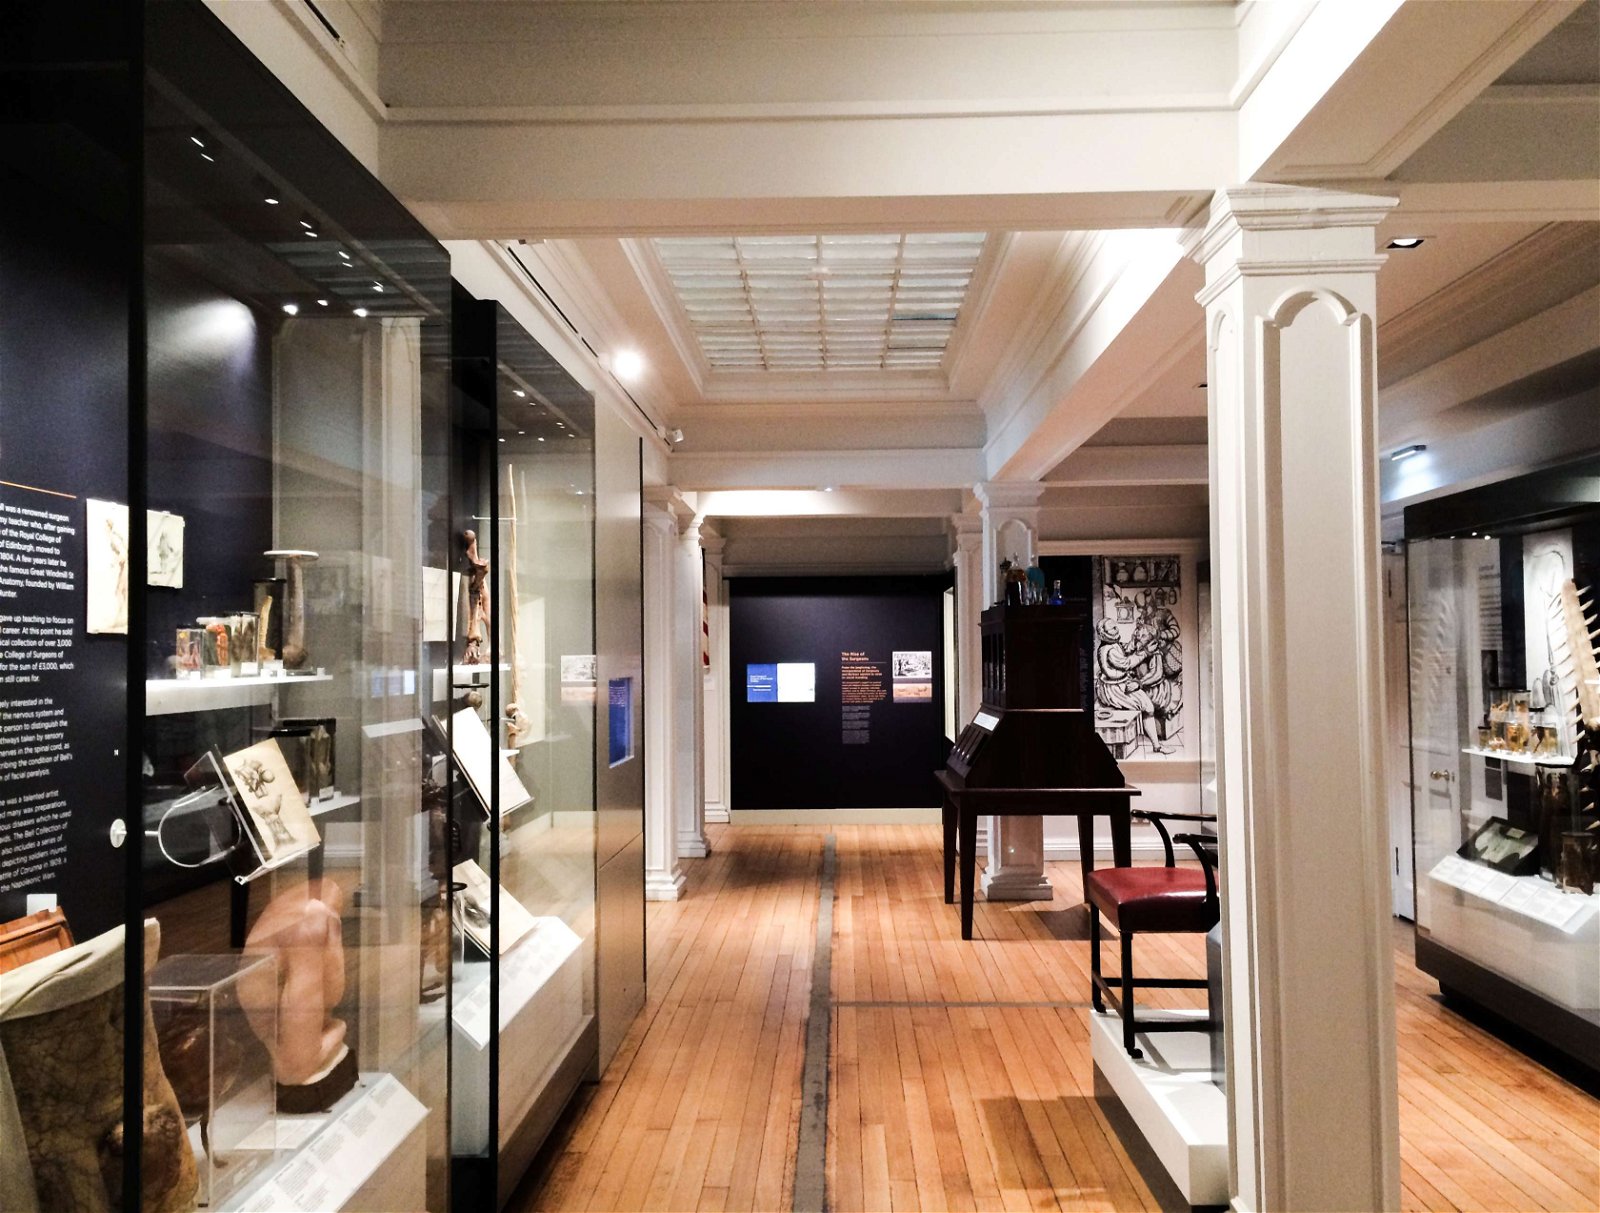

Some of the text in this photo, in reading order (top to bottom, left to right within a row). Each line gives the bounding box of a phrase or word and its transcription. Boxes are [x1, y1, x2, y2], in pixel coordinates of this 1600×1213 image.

[22, 509, 48, 519] renowned
[49, 513, 69, 522] surgeon
[8, 517, 29, 527] teacher
[43, 523, 56, 531] after
[57, 526, 75, 536] gaining
[2, 528, 62, 544] of the Royal College of
[35, 546, 54, 554] moved
[16, 554, 21, 562] A
[22, 555, 32, 563] few
[32, 558, 47, 566] years
[47, 558, 59, 566] later
[60, 559, 67, 567] he
[9, 565, 30, 575] famous
[30, 568, 45, 577] Great
[45, 570, 68, 579] Windmill
[25, 579, 48, 588] founded
[48, 581, 55, 591] by
[55, 582, 74, 590] William
[22, 615, 45, 625] teaching
[46, 616, 52, 624] to
[52, 616, 66, 624] focus
[22, 627, 28, 635] At
[40, 628, 54, 636] point
[54, 628, 61, 636] he
[10, 639, 37, 647] collection
[37, 639, 44, 647] of
[4, 651, 25, 660] College
[26, 651, 32, 659] of
[33, 651, 57, 660] Surgeons
[57, 651, 64, 659] of
[5, 675, 15, 683] still
[10, 698, 38, 707] interested
[44, 697, 53, 705] the
[35, 710, 54, 719] system
[54, 708, 64, 716] and
[3, 725, 23, 733] person
[30, 721, 59, 730] distinguish
[20, 735, 36, 743] taken
[36, 733, 44, 742] by
[34, 744, 50, 754] spinal
[28, 756, 53, 766] condition
[53, 754, 60, 762] of
[4, 773, 11, 781] of
[11, 772, 26, 780] facial
[23, 792, 45, 802] talented
[45, 790, 59, 798] artist
[34, 801, 67, 813] preparations
[12, 819, 35, 829] diseases
[36, 815, 51, 823] which
[59, 811, 72, 819] used
[24, 830, 35, 838] Bell
[35, 825, 61, 836] Collection
[62, 822, 68, 830] of
[1, 848, 13, 856] also
[13, 842, 36, 851] includes
[41, 838, 56, 846] series
[56, 834, 63, 842] of
[2, 845, 68, 868] depicting soldiers injured
[12, 869, 19, 877] of
[11, 877, 41, 889] Napoleonic
